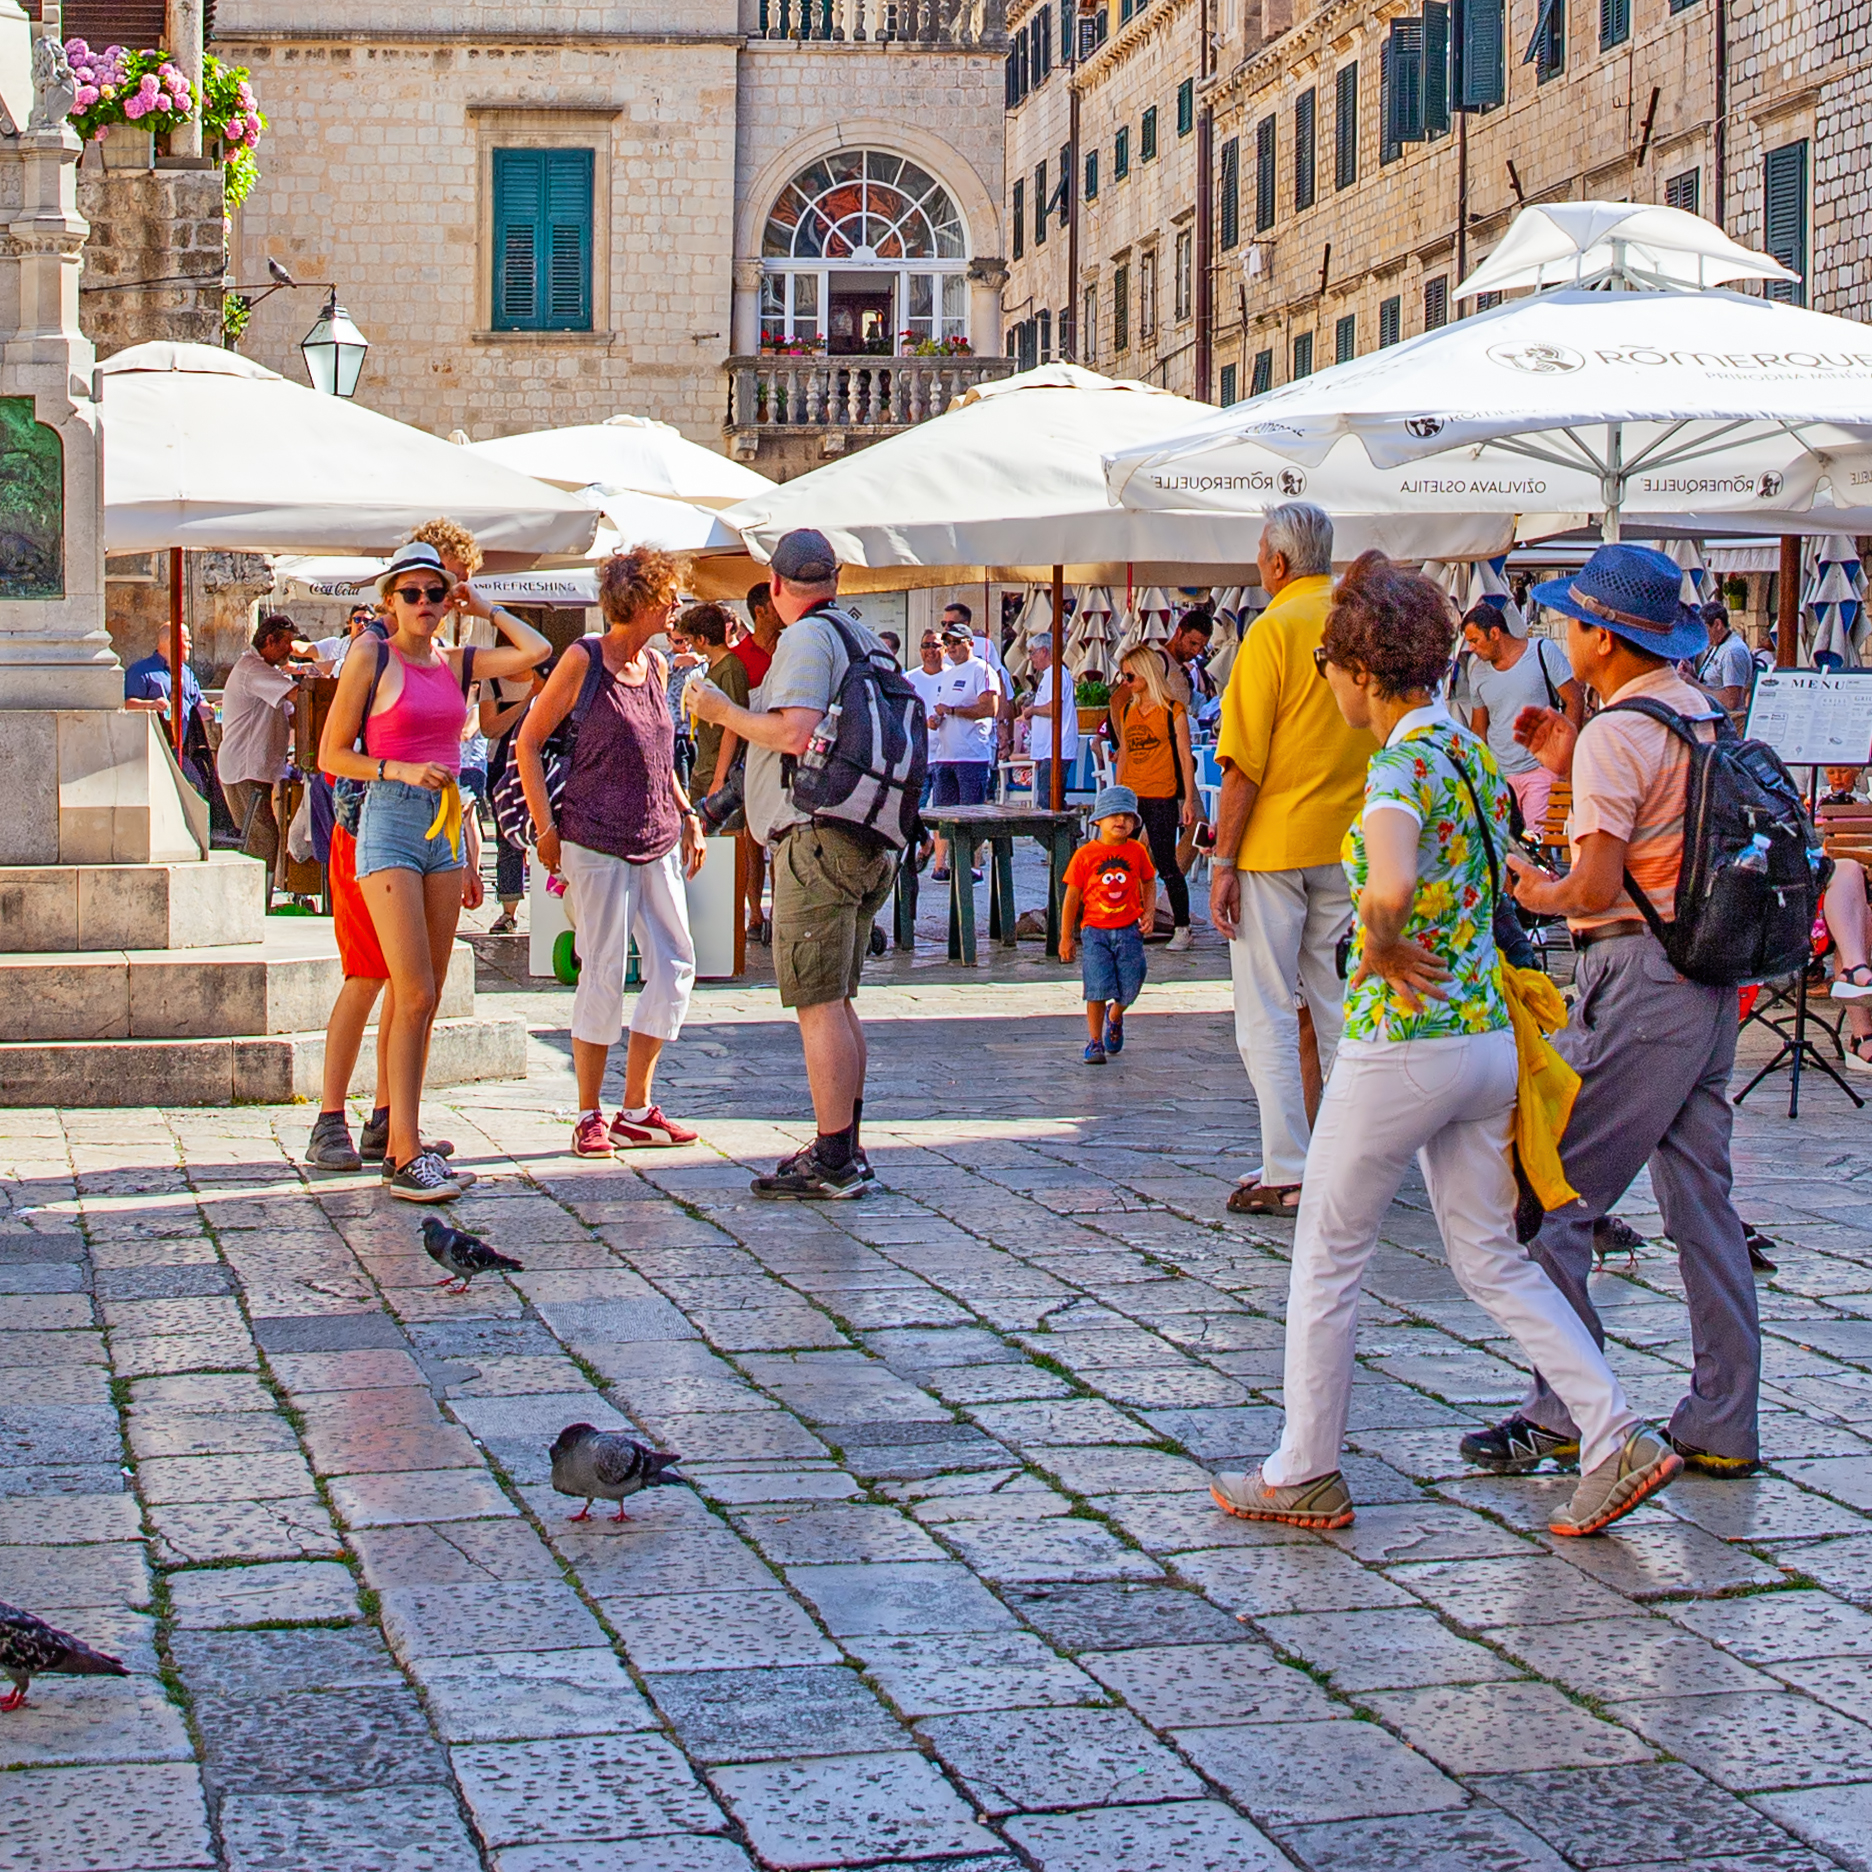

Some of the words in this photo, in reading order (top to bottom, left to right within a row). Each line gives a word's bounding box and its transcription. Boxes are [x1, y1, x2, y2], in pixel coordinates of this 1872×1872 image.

[1704, 370, 1807, 383] PRIRODNA
[492, 581, 577, 592] REFRESHING
[1790, 678, 1846, 691] MENU
